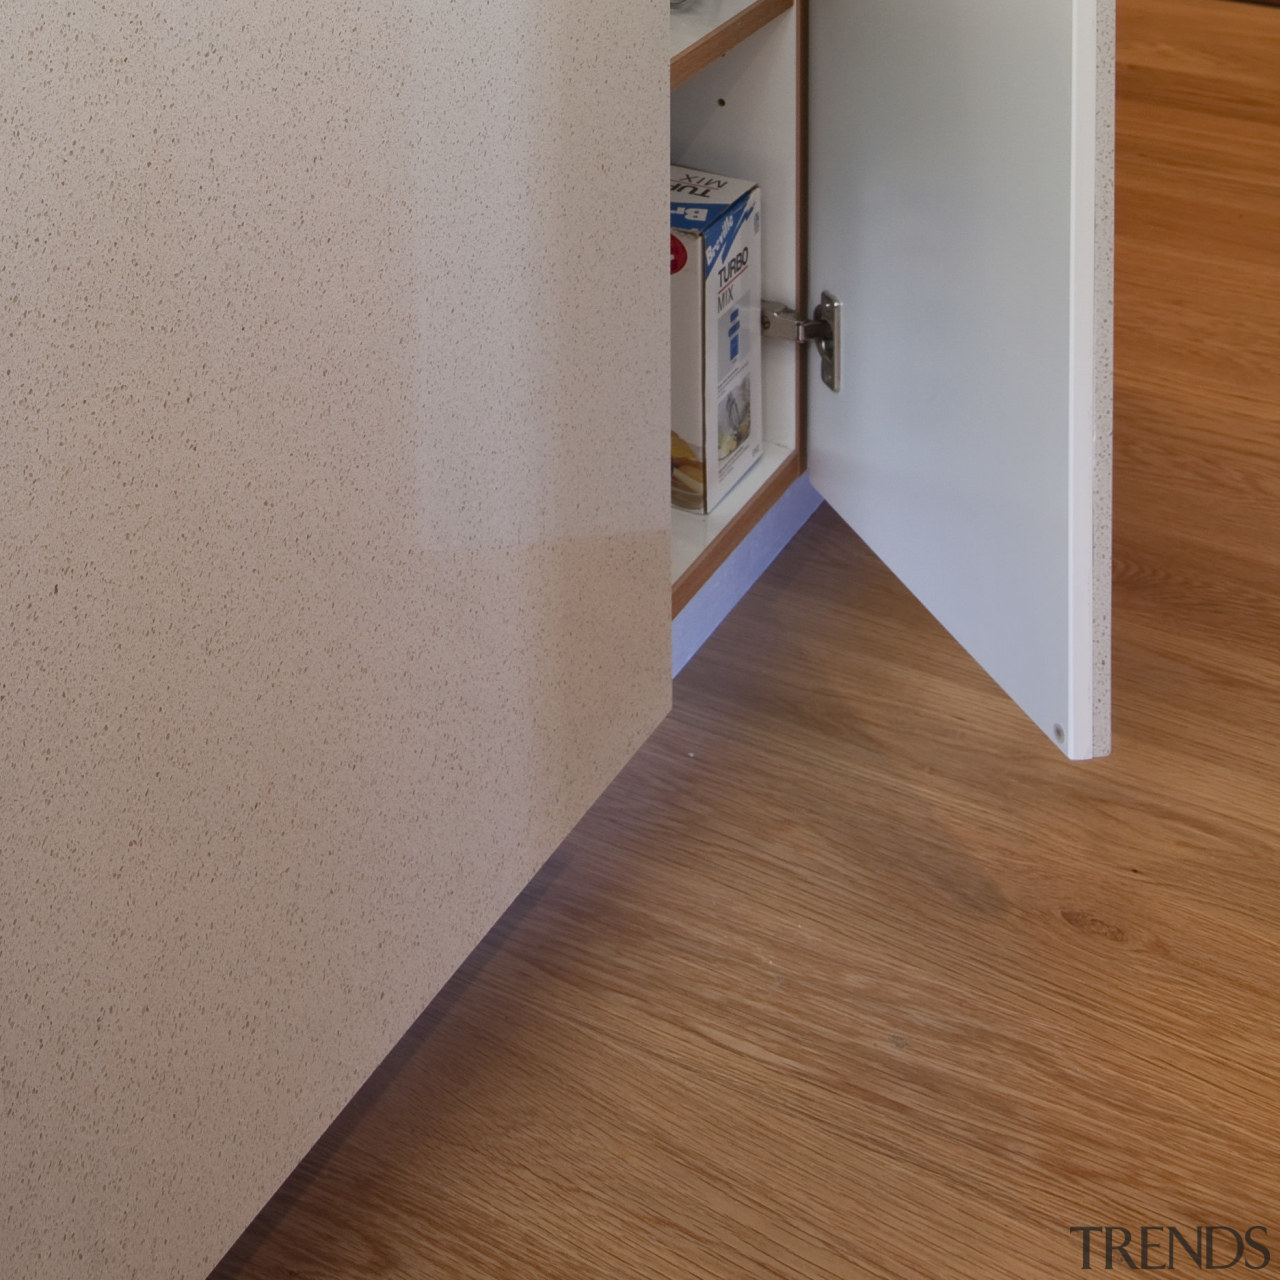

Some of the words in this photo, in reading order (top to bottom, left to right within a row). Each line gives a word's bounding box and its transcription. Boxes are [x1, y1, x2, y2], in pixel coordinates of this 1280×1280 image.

[685, 173, 728, 189] MIX
[706, 215, 734, 265] Breville
[718, 246, 749, 287] TURBO
[718, 284, 734, 313] MIX
